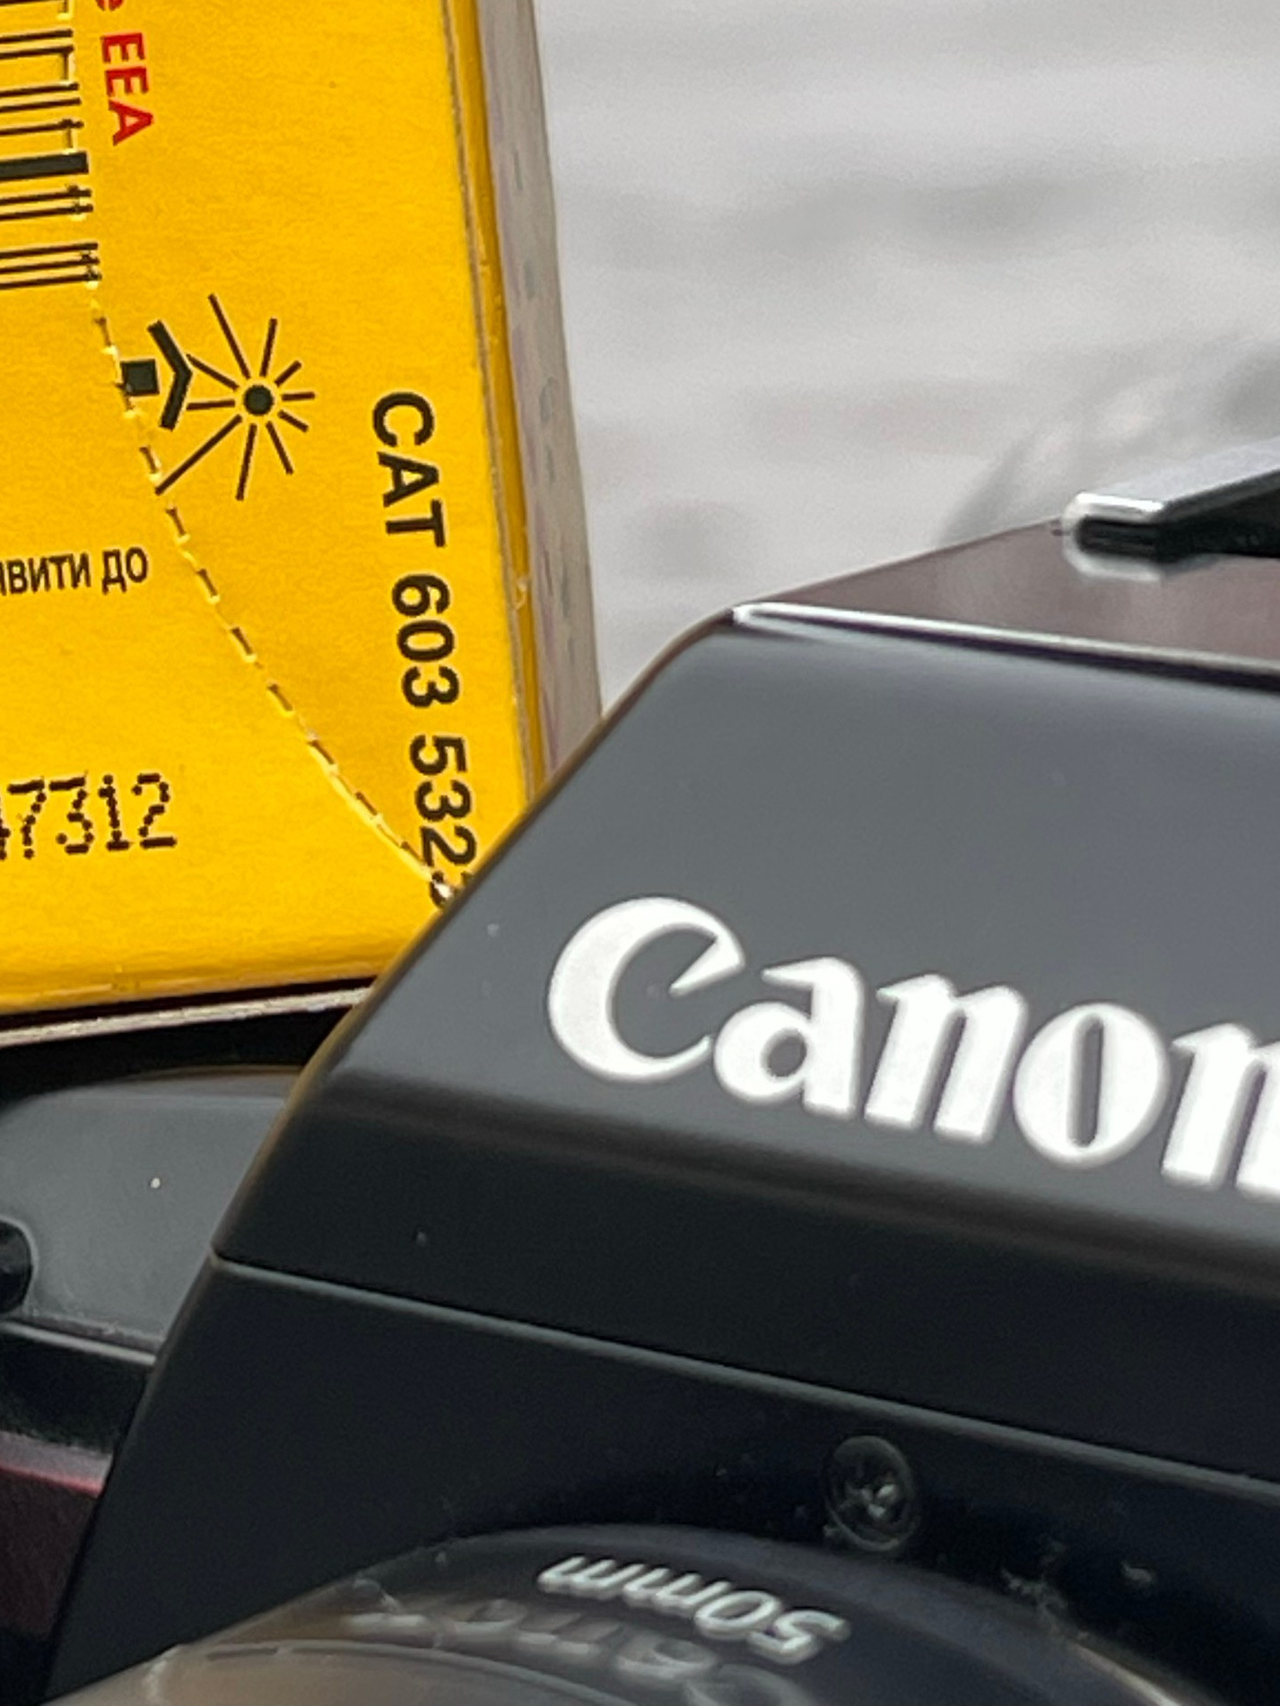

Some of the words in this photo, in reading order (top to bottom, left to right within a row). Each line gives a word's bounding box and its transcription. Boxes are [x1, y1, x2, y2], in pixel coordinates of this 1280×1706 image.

[100, 31, 155, 146] EEA
[372, 391, 446, 548] CAT
[101, 546, 149, 595] ДО
[391, 573, 460, 710] 603
[547, 895, 1280, 1201] Canon
[536, 1553, 852, 1665] 50mm
